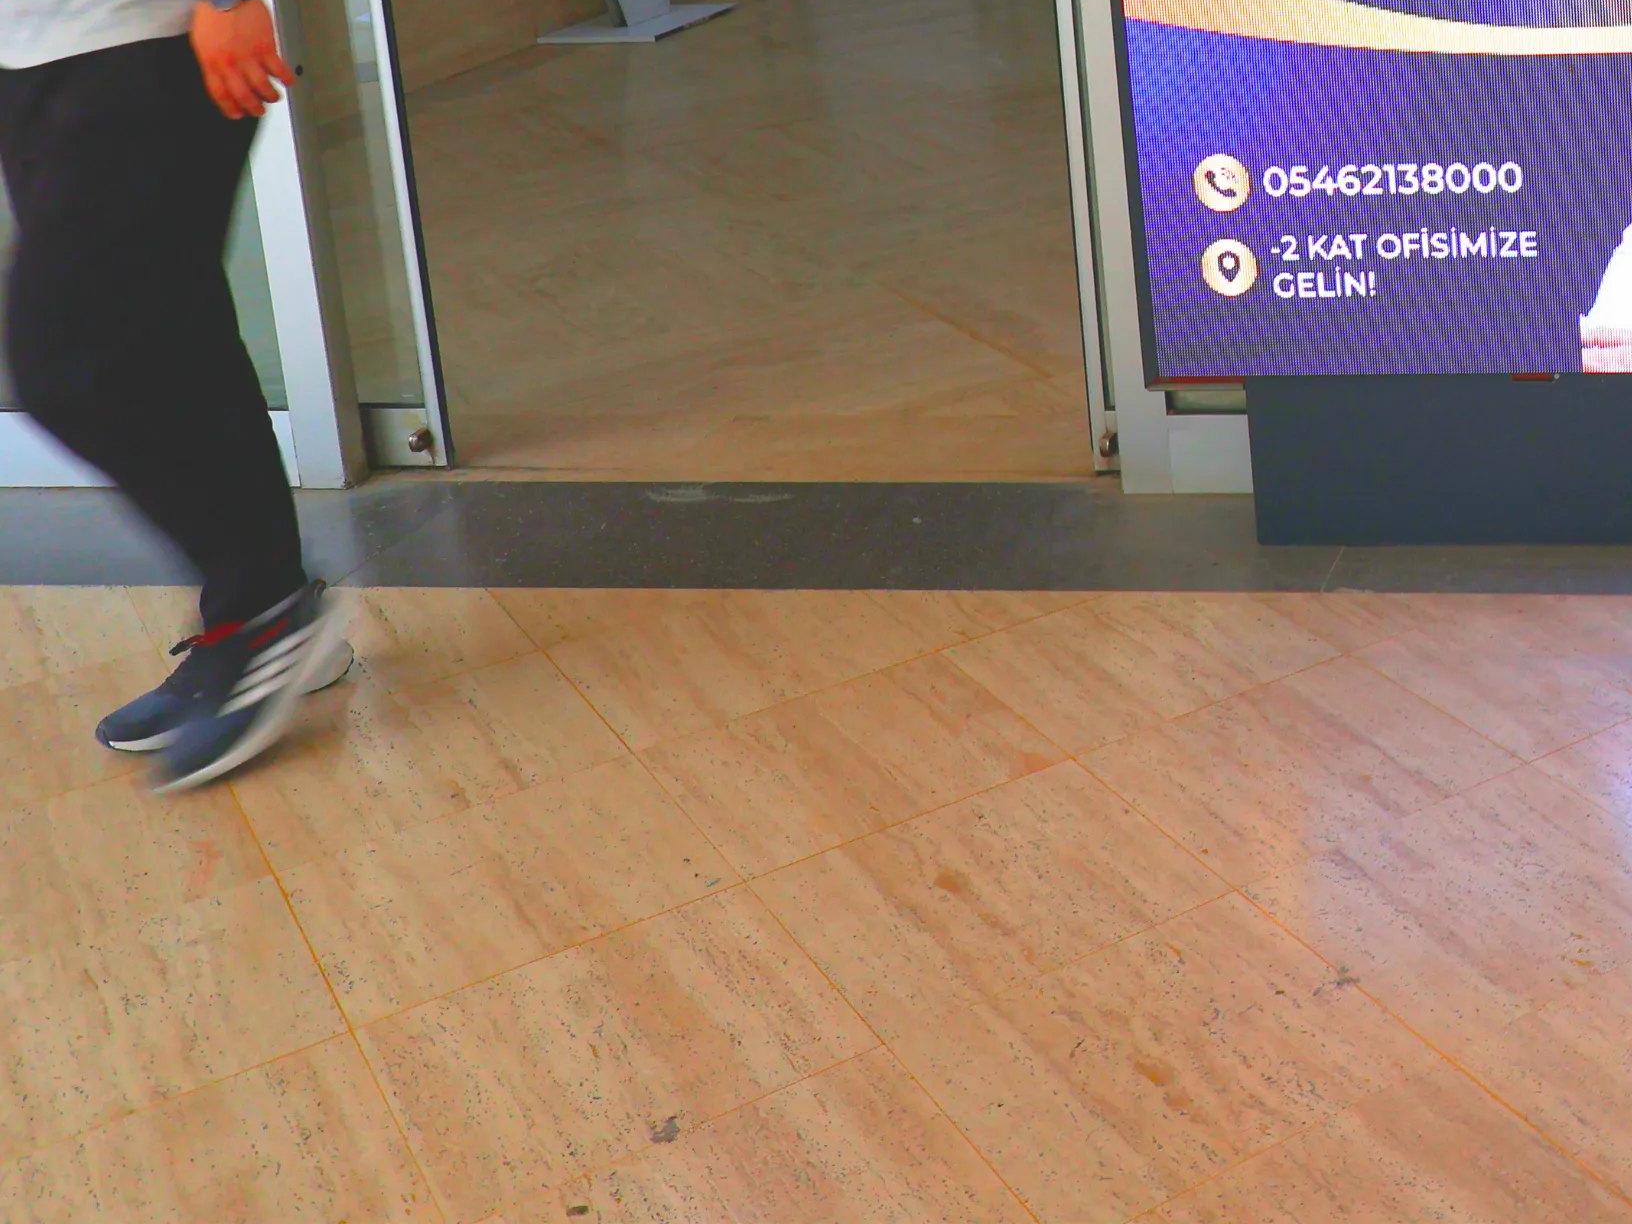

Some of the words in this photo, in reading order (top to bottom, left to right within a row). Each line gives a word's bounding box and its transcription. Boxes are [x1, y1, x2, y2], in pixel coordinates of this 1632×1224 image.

[1262, 160, 1524, 198] 05462138000
[1270, 234, 1300, 262] -2
[1308, 233, 1368, 261] KAT
[1375, 226, 1539, 260] OFİSİMİZE
[1272, 266, 1377, 299] GELİN!
